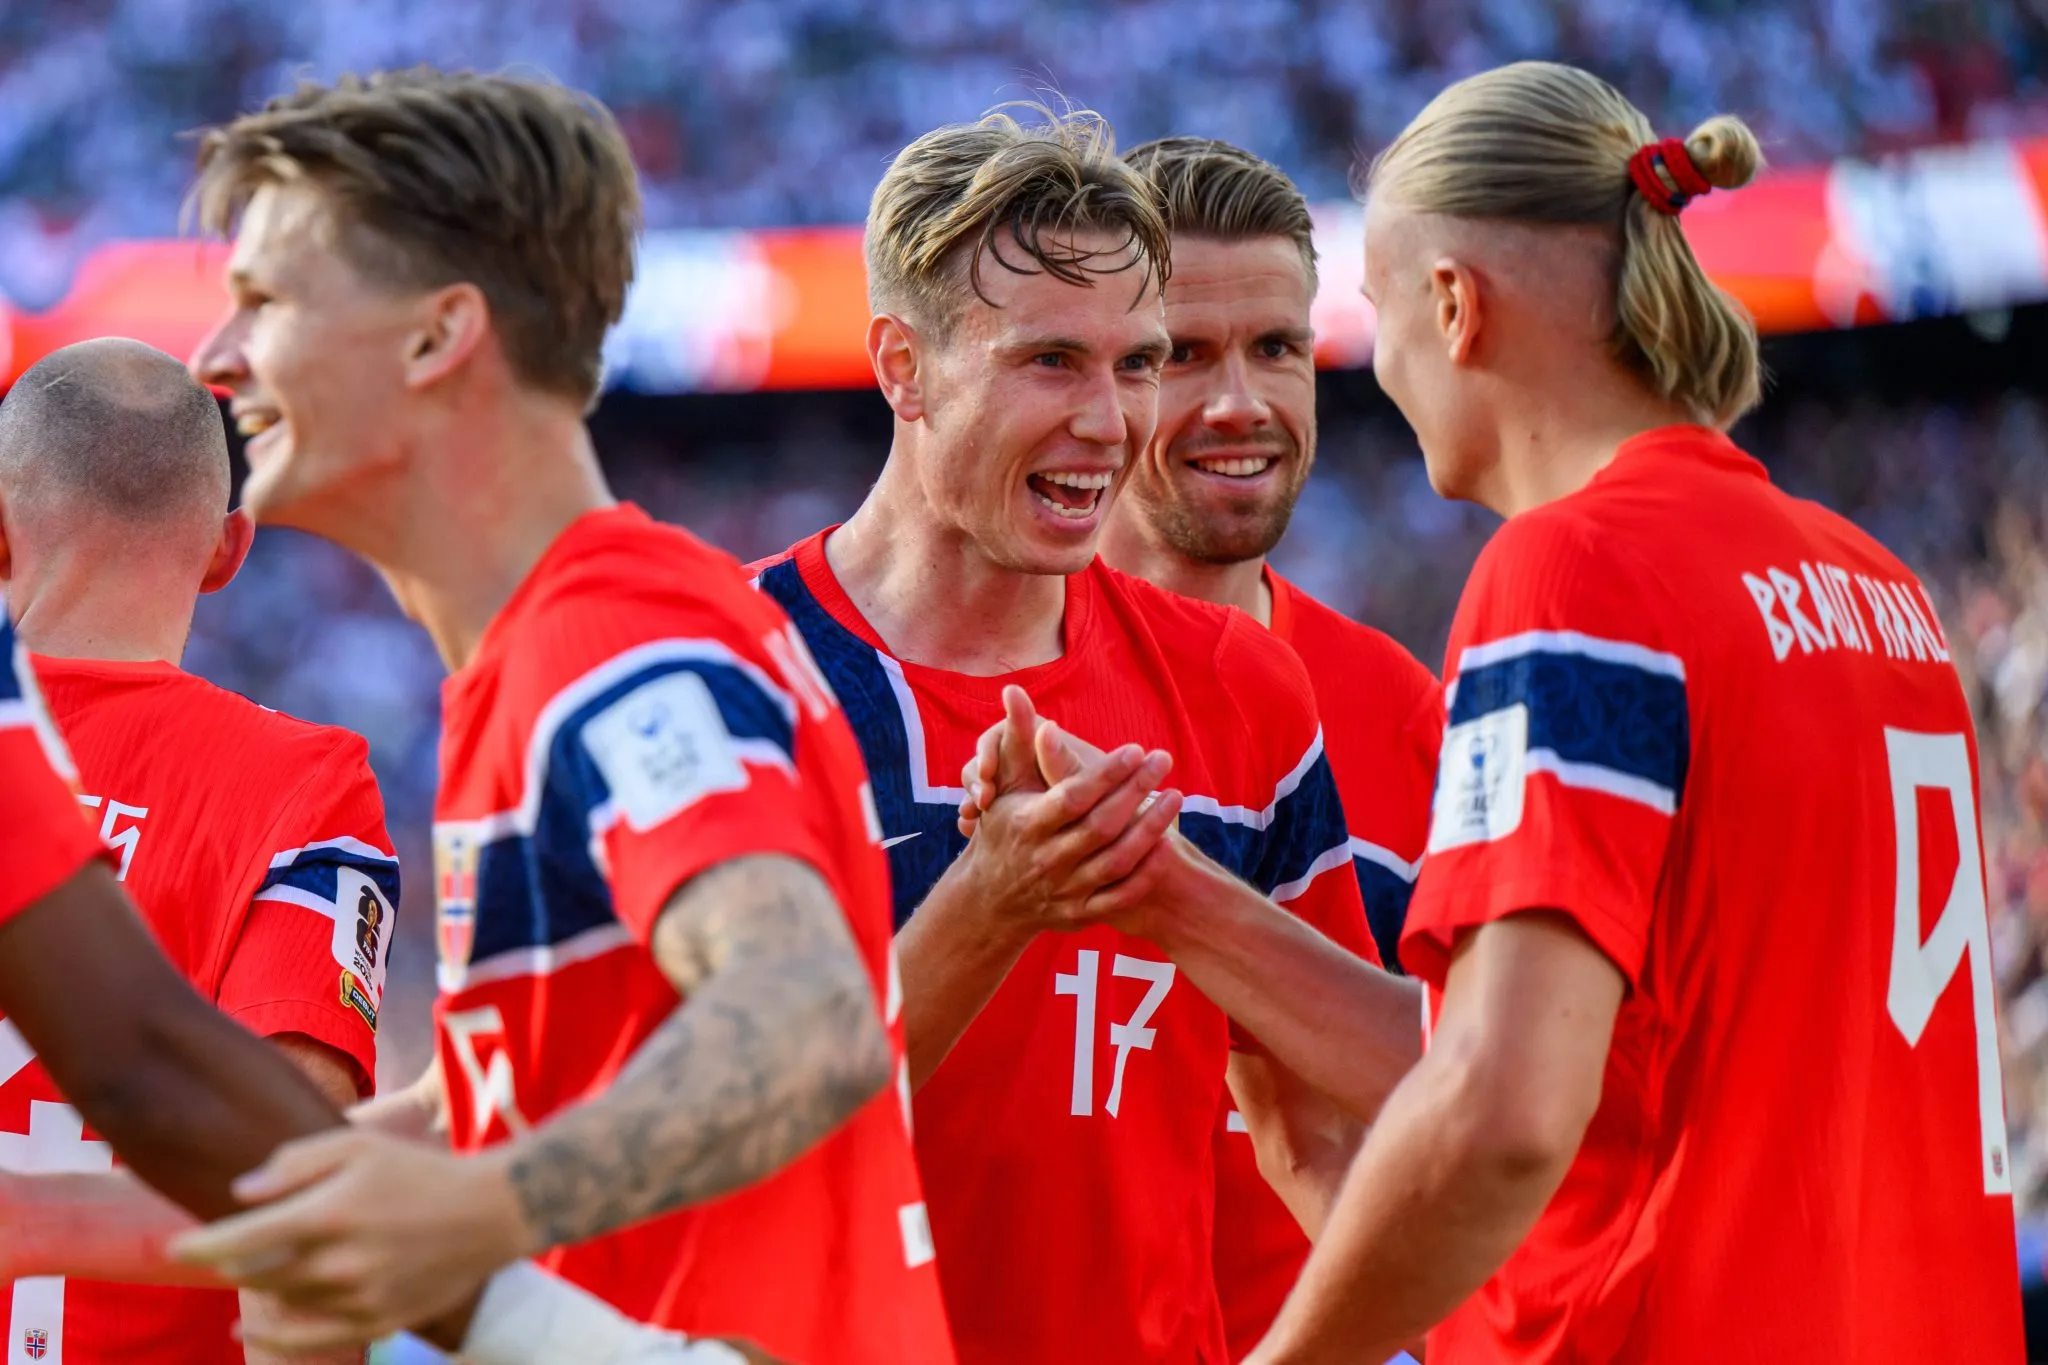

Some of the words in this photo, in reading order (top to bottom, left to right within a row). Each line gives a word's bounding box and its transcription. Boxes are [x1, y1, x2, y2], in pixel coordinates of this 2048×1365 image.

[1742, 560, 1873, 663] BRAUT
[1853, 572, 1951, 663] HAAL
[352, 989, 376, 1019] DEBUT
[1883, 725, 2013, 1196] 9
[1055, 949, 1176, 1119] 17
